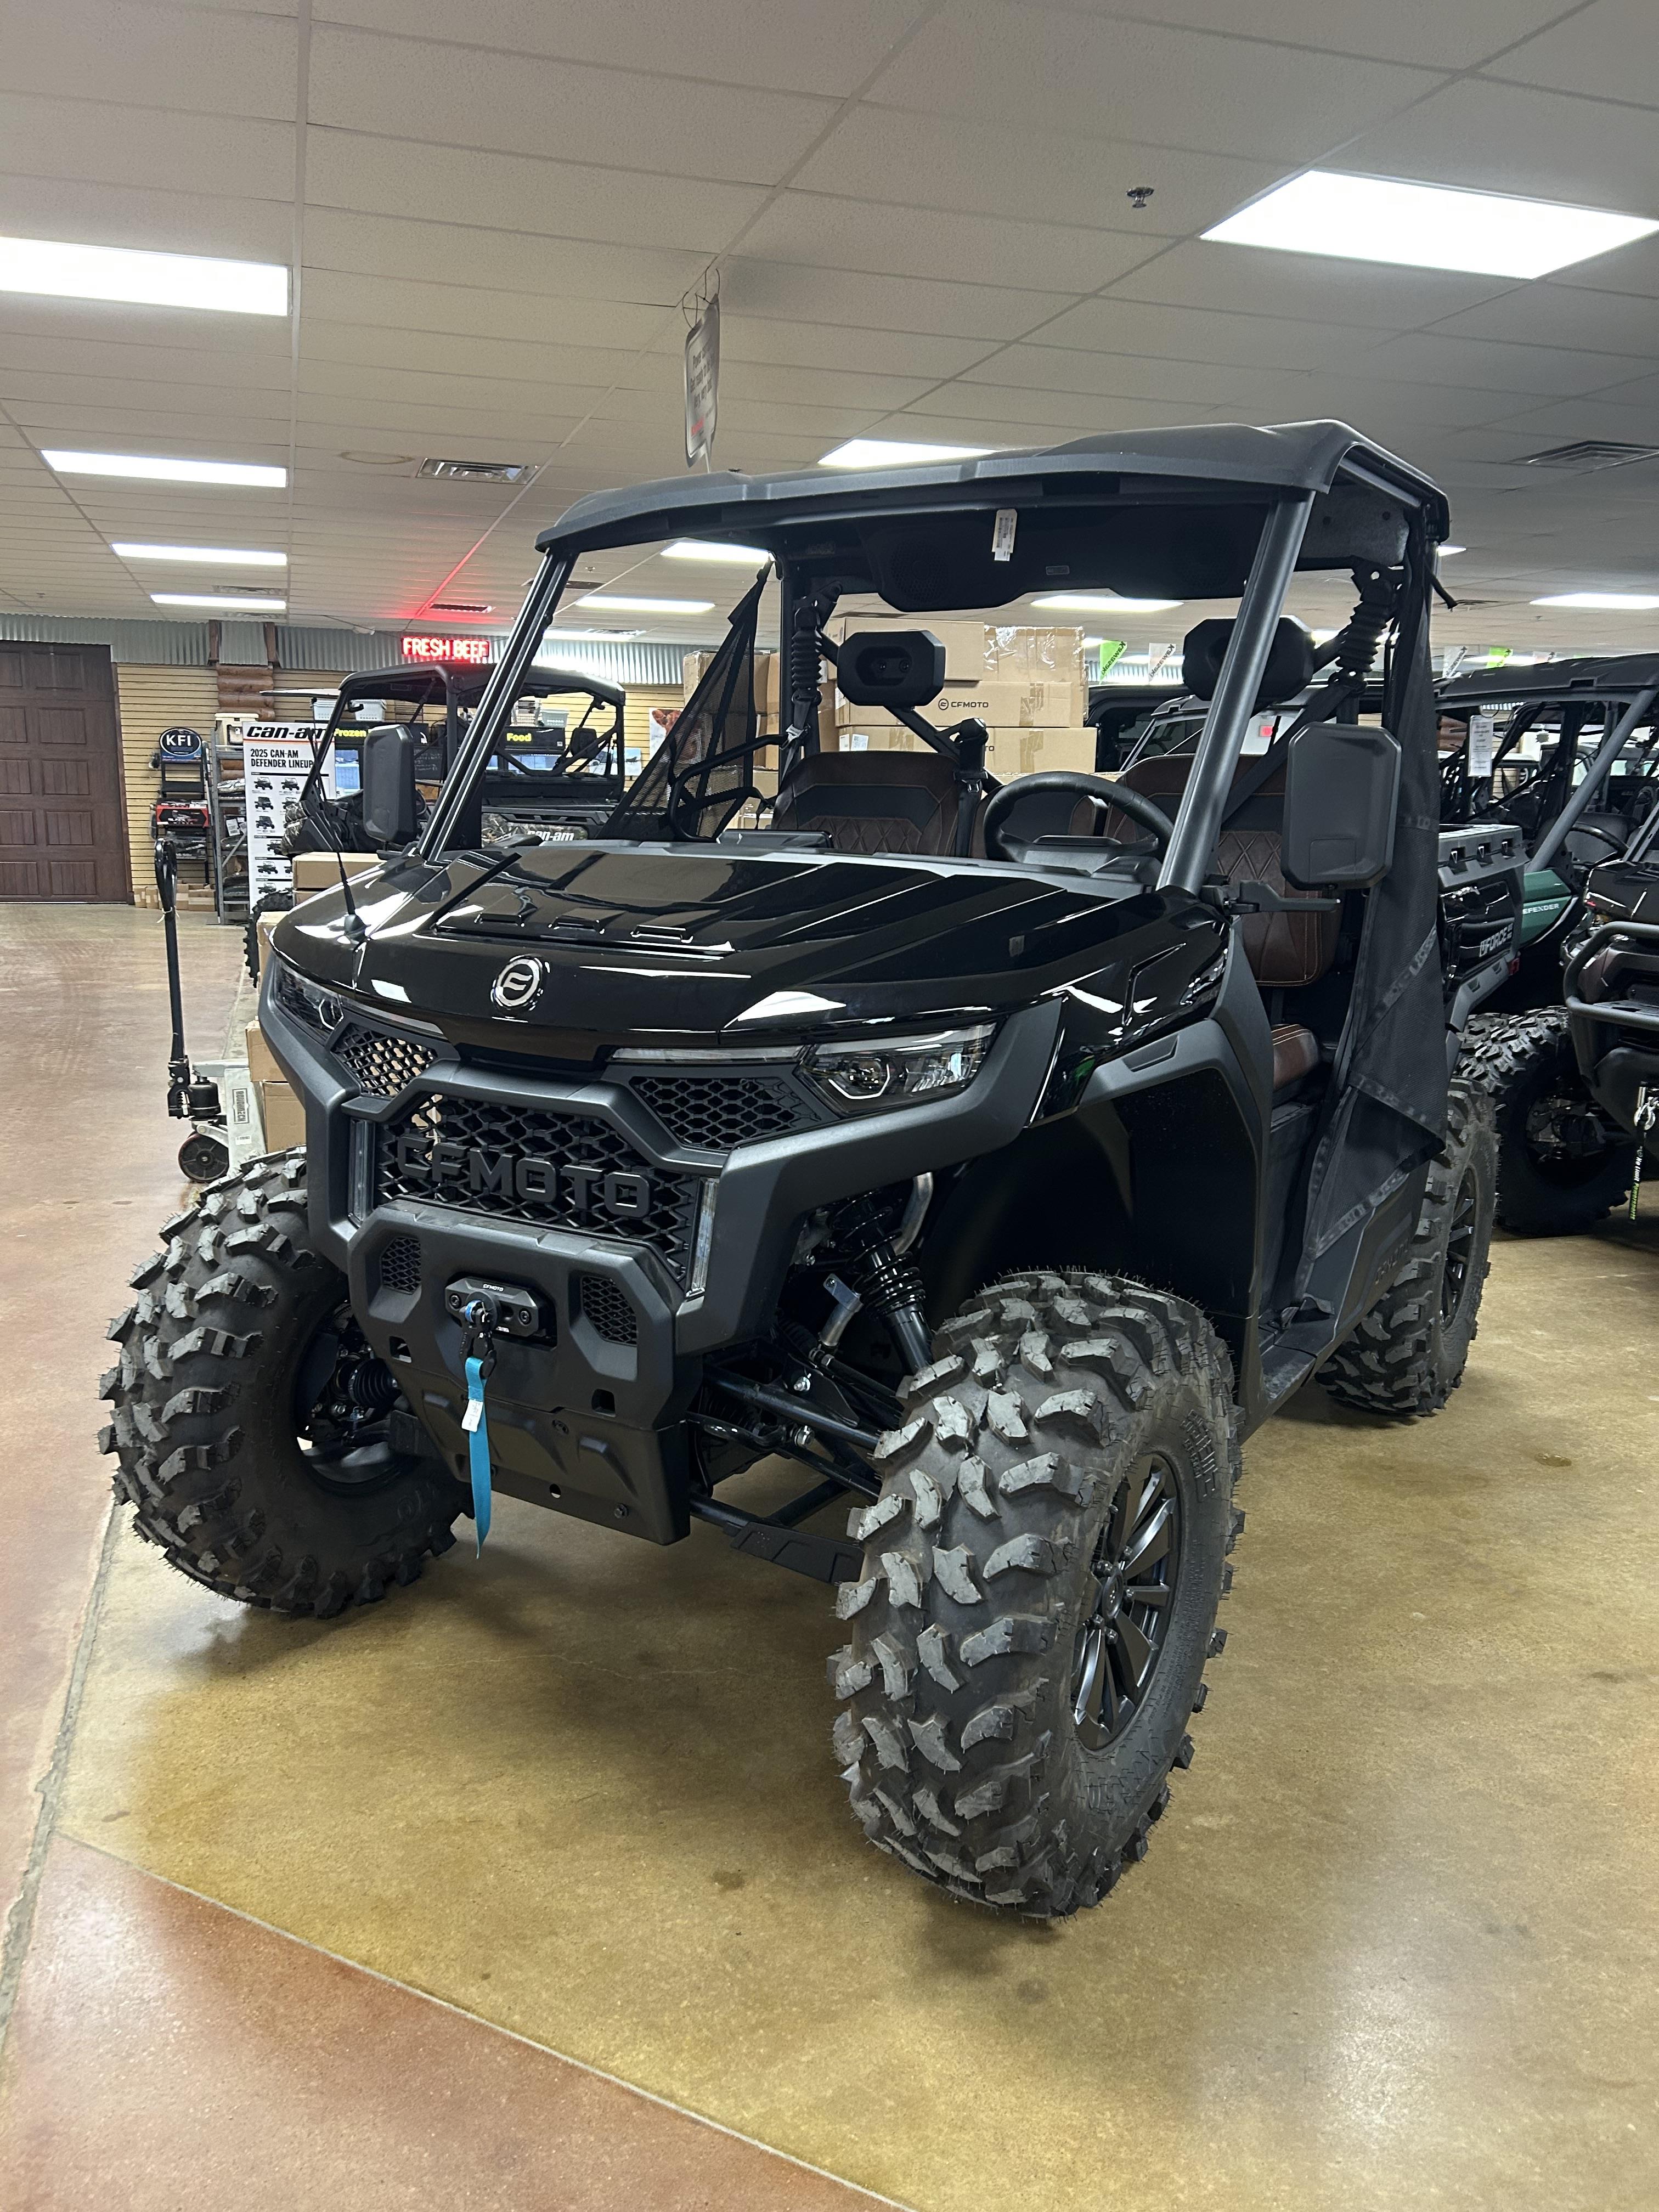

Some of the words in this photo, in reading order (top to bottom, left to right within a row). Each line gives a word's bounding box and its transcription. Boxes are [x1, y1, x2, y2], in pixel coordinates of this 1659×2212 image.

[403, 637, 450, 657] FRESH
[453, 640, 488, 659] BEEF
[334, 728, 366, 737] Frozen
[506, 733, 532, 741] Food
[166, 735, 191, 746] KFI
[250, 748, 268, 757] 2025
[270, 749, 298, 758] CAN-AM
[251, 758, 286, 768] DEFENDER
[289, 759, 313, 768] LINEUP
[1523, 903, 1559, 915] EFENDER
[398, 1136, 651, 1218] CFMOTO
[483, 1284, 504, 1292] CFMOTO
